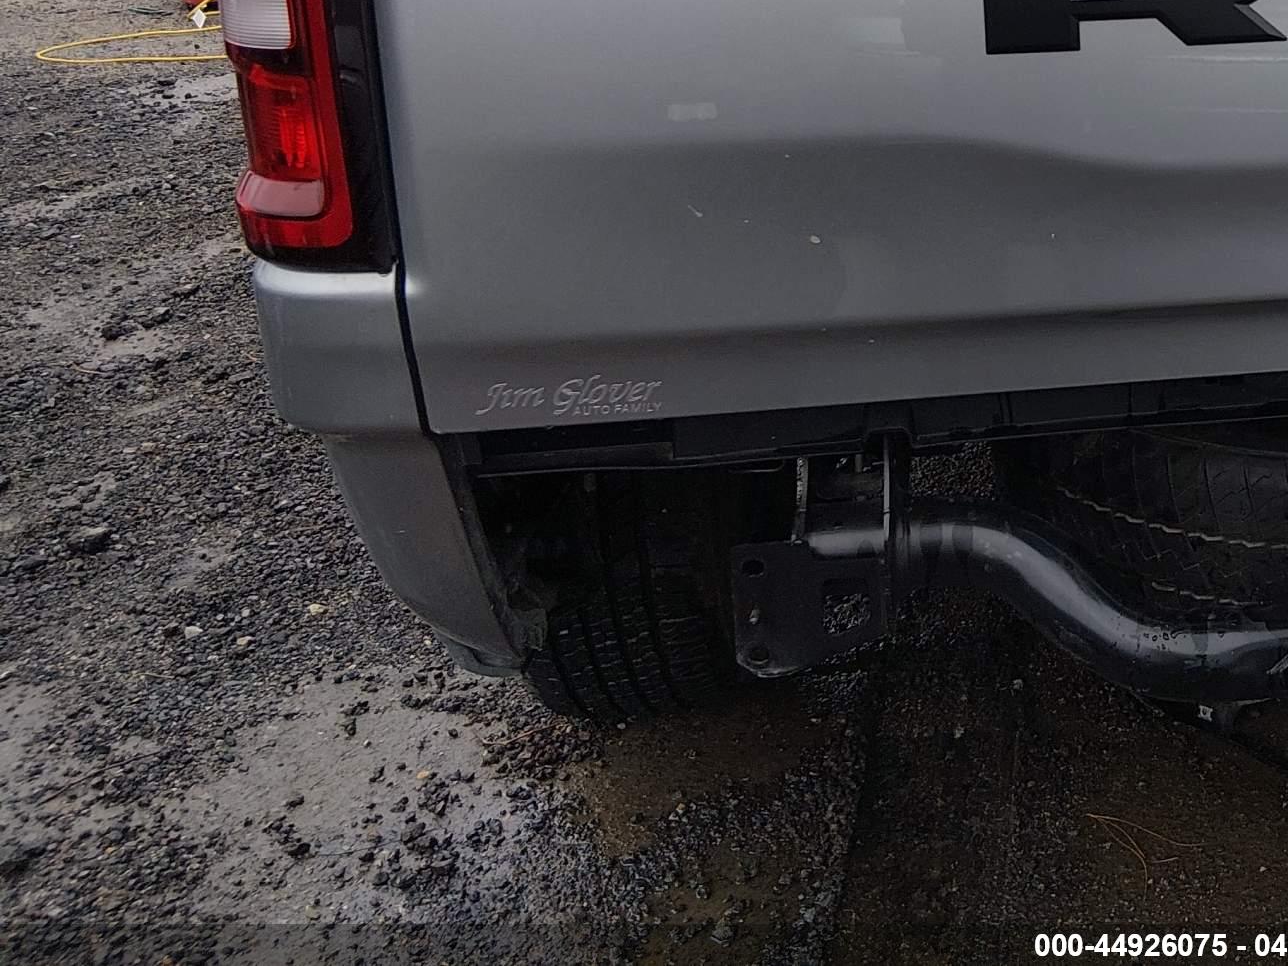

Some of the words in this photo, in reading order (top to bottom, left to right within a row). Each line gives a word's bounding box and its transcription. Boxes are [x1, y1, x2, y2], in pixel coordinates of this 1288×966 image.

[475, 381, 545, 415] Jim
[552, 375, 663, 415] Glover
[571, 404, 610, 417] AUTO
[614, 401, 663, 415] FAMILY
